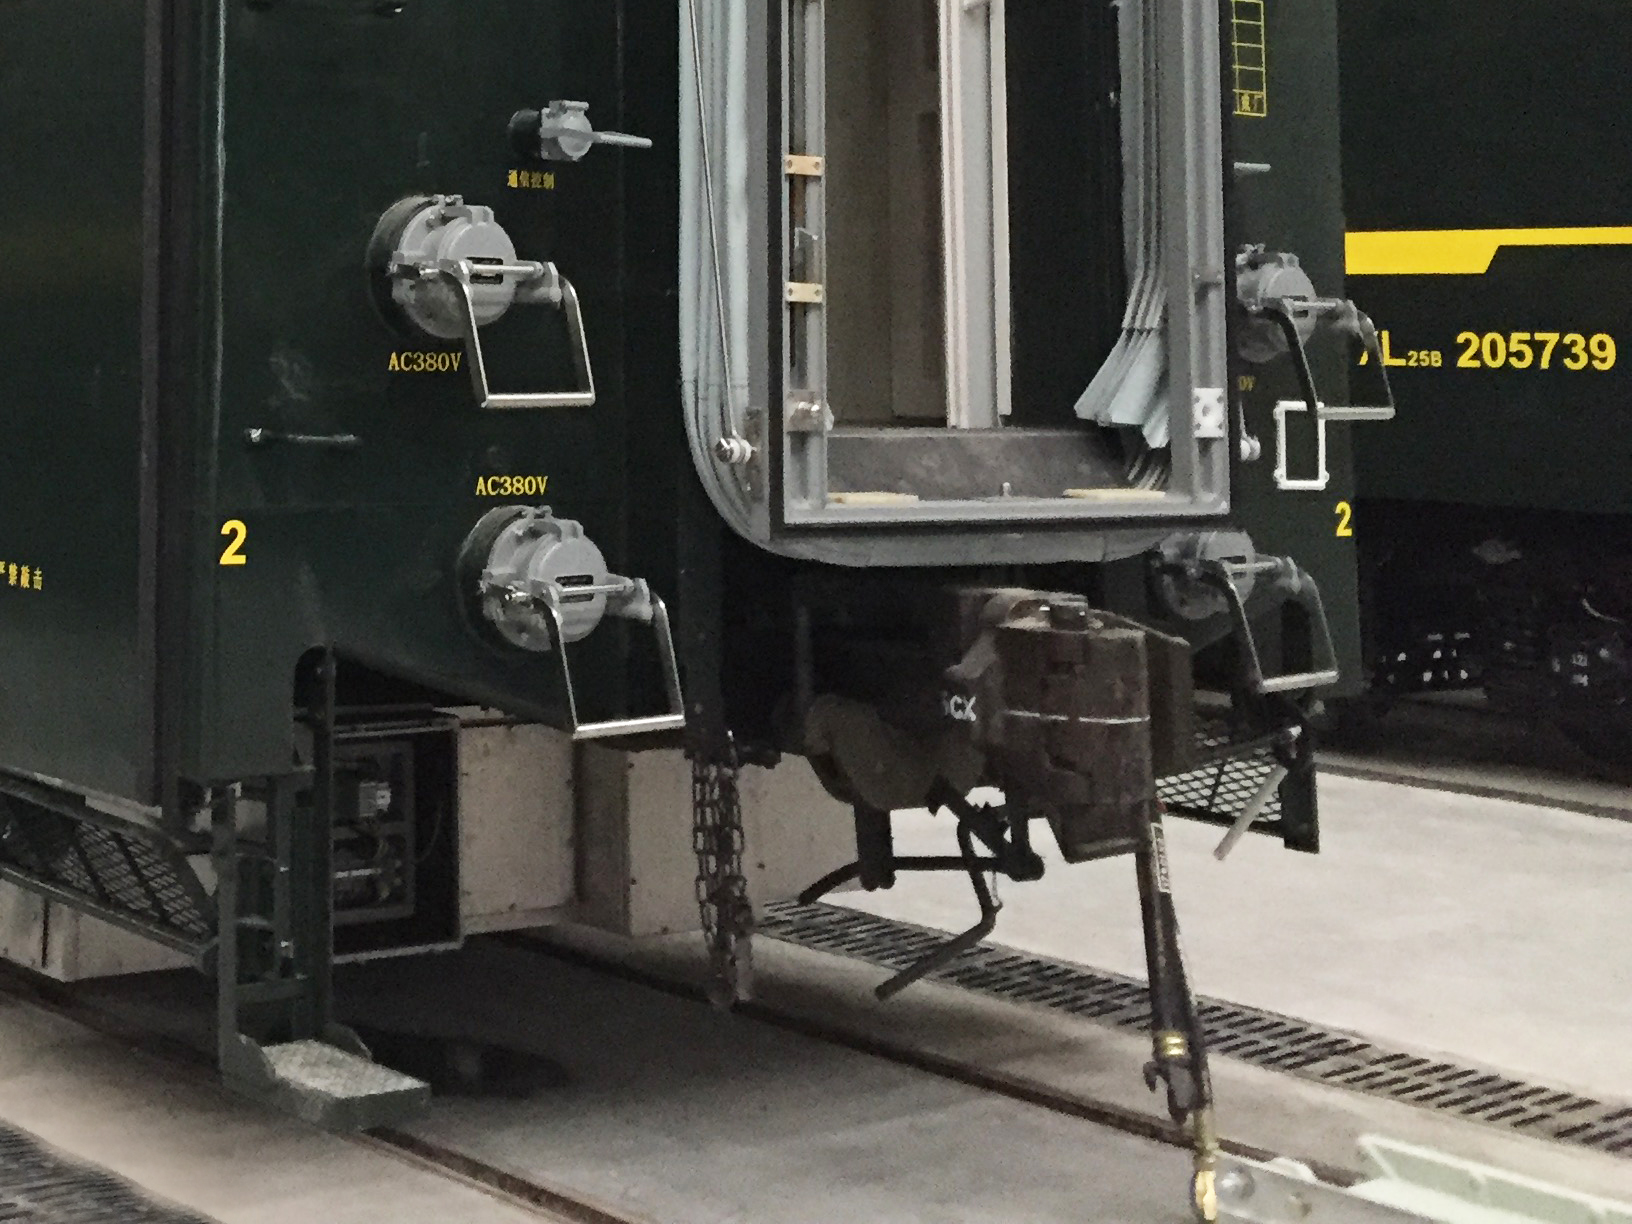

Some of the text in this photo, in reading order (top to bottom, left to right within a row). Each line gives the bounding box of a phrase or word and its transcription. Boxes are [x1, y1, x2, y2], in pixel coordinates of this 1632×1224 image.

[388, 351, 461, 372] AC380V
[1455, 330, 1617, 372] 205739
[475, 475, 549, 497] AC380V
[1335, 501, 1354, 538] 2
[219, 519, 248, 566] 2
